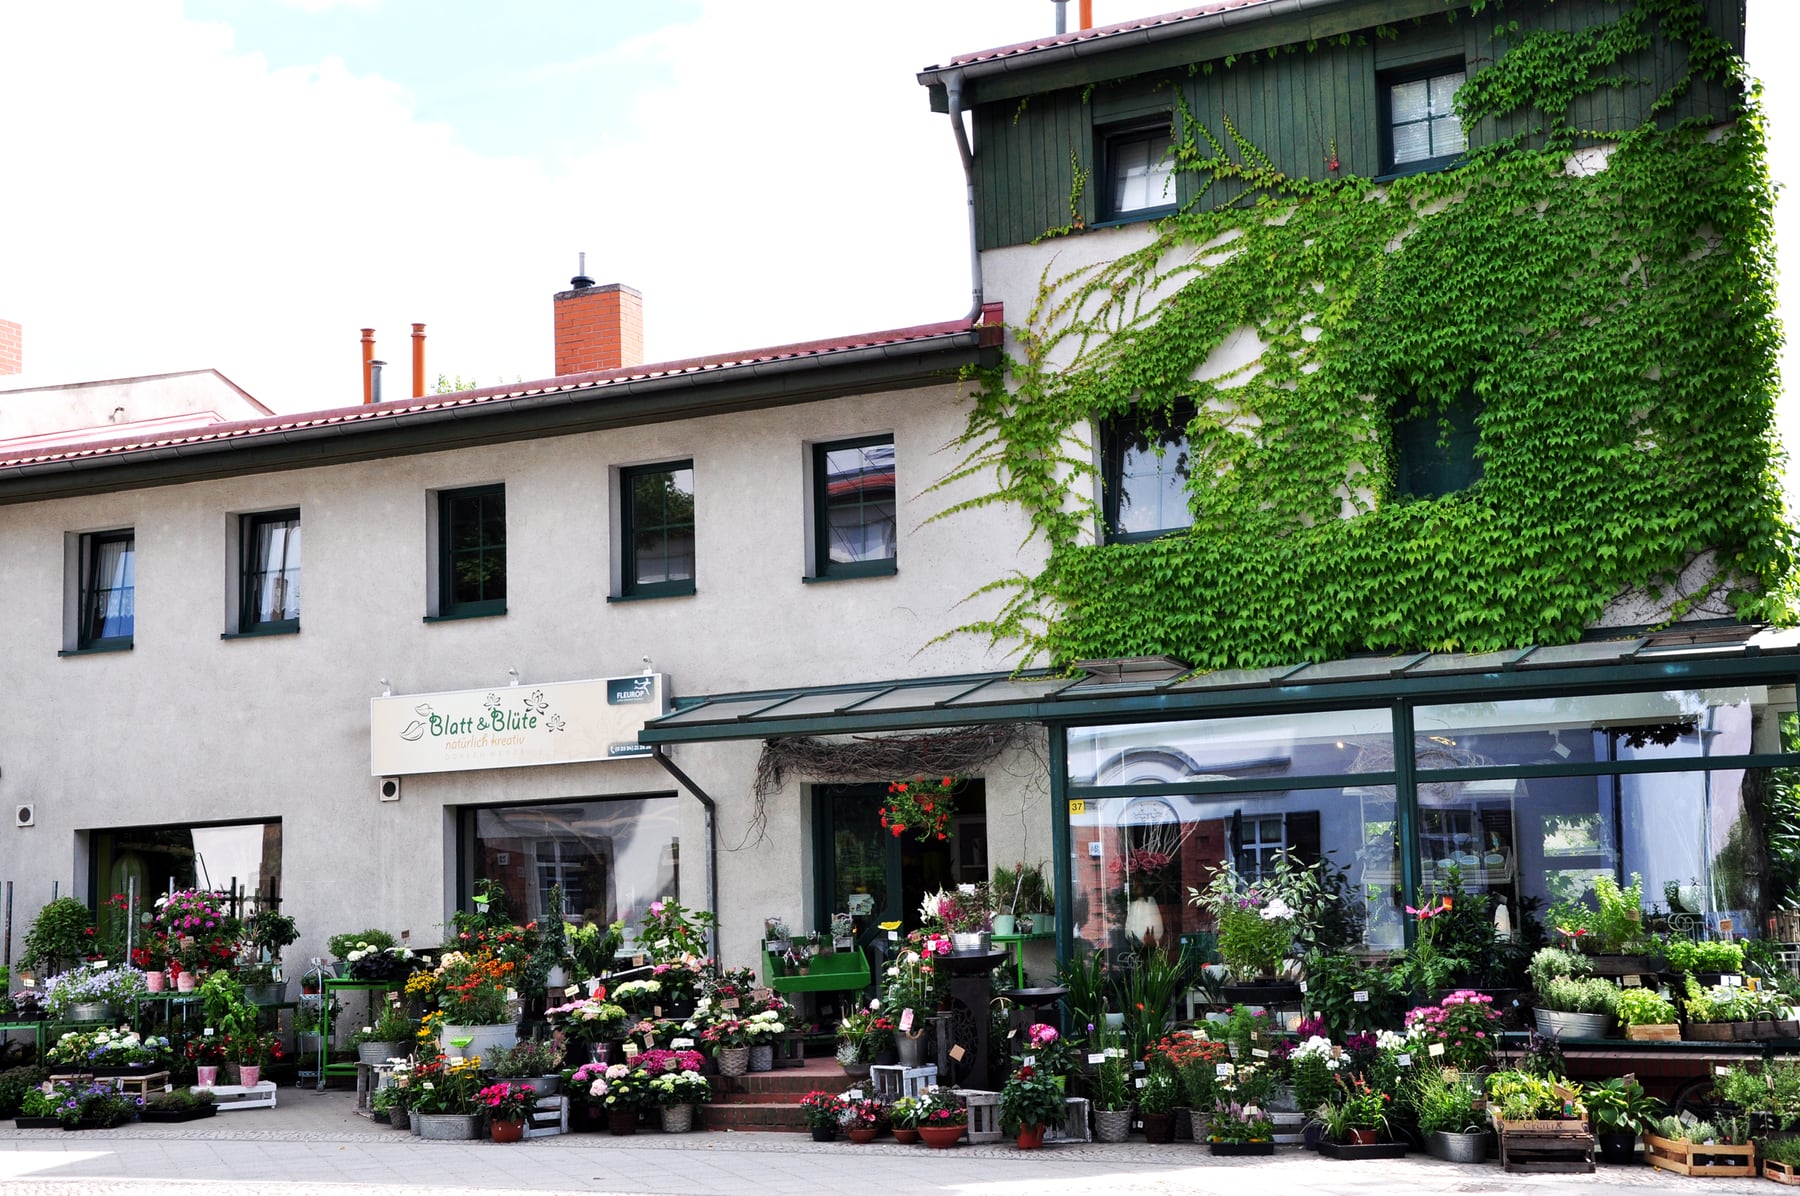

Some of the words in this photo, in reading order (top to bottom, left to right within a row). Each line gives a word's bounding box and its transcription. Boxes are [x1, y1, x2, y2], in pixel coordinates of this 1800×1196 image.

[429, 712, 473, 737] Blatt
[476, 716, 491, 731] &
[490, 707, 538, 732] Blüte
[445, 734, 488, 750] natürlich
[490, 733, 525, 748] kreativ
[1071, 802, 1083, 811] 37
